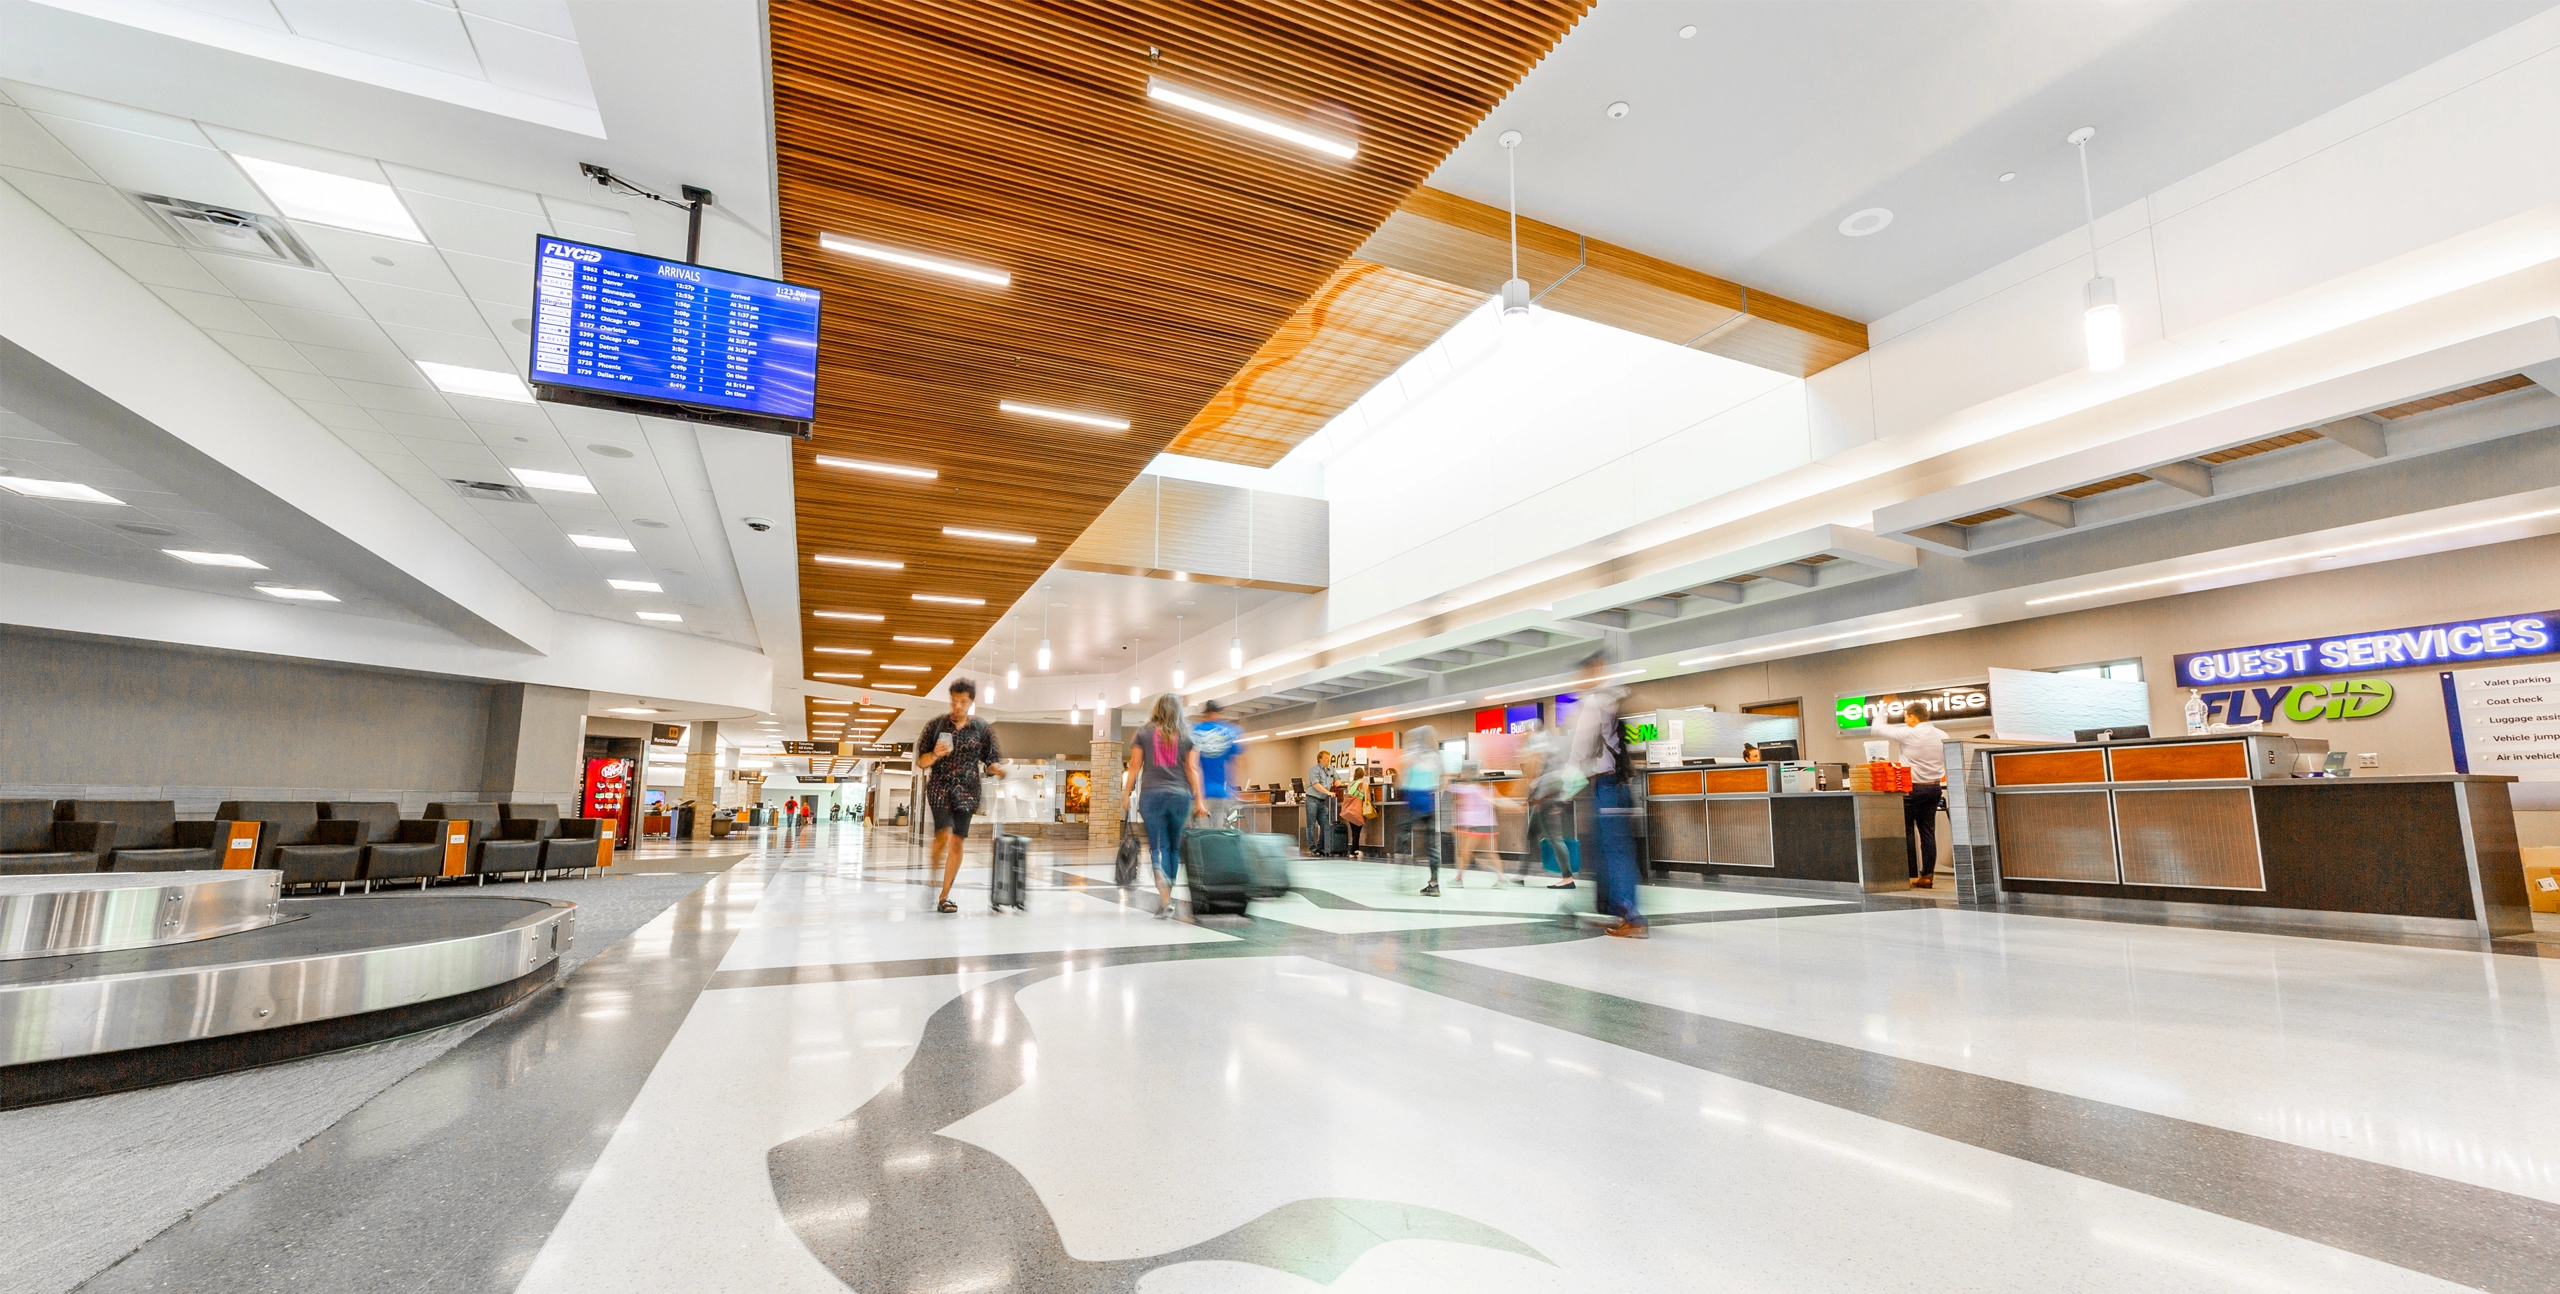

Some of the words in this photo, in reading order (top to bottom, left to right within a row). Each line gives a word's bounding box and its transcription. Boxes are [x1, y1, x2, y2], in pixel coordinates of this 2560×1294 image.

[658, 265, 700, 282] ARRIVALS
[602, 288, 636, 298] Minneapolis
[602, 297, 624, 306] Chicago
[601, 306, 627, 315] Nashville
[600, 316, 623, 324] Chicago
[600, 325, 627, 333] Charlotte
[600, 334, 622, 343] Chicago
[599, 343, 619, 351] Detroit
[598, 362, 621, 370] Phoenix
[2187, 645, 2312, 681] GUEST
[2319, 618, 2547, 669] SERVICES
[2484, 678, 2510, 686] Valet
[2512, 676, 2552, 686] parking
[2512, 696, 2543, 704] check
[2493, 734, 2530, 742] Vehicle
